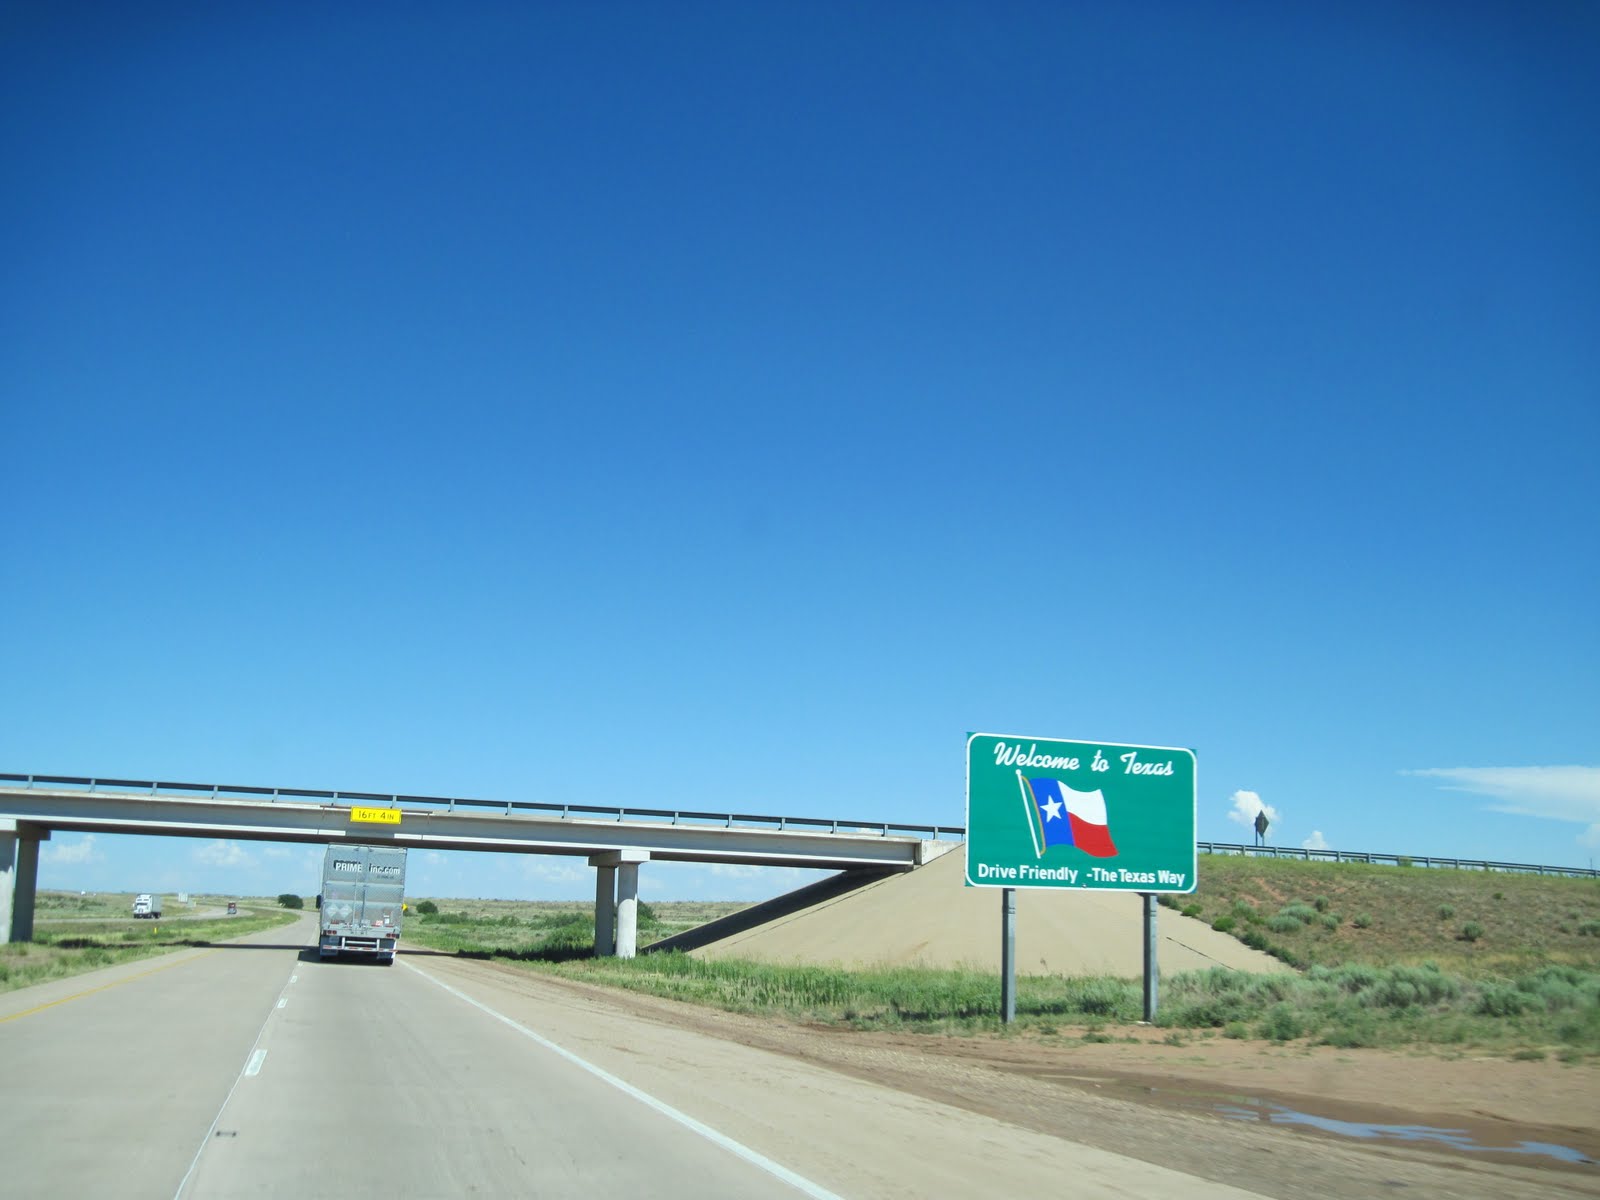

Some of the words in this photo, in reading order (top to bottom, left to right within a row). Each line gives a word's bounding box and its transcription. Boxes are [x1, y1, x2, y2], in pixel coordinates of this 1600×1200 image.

[994, 741, 1080, 770] Welcome
[1090, 749, 1110, 772] to
[1120, 751, 1174, 776] Texas
[334, 860, 363, 873] PRIME
[978, 863, 1017, 879] Drive
[1019, 865, 1078, 884] Friendly
[1119, 868, 1155, 884] Texas
[1157, 869, 1186, 887] Way
